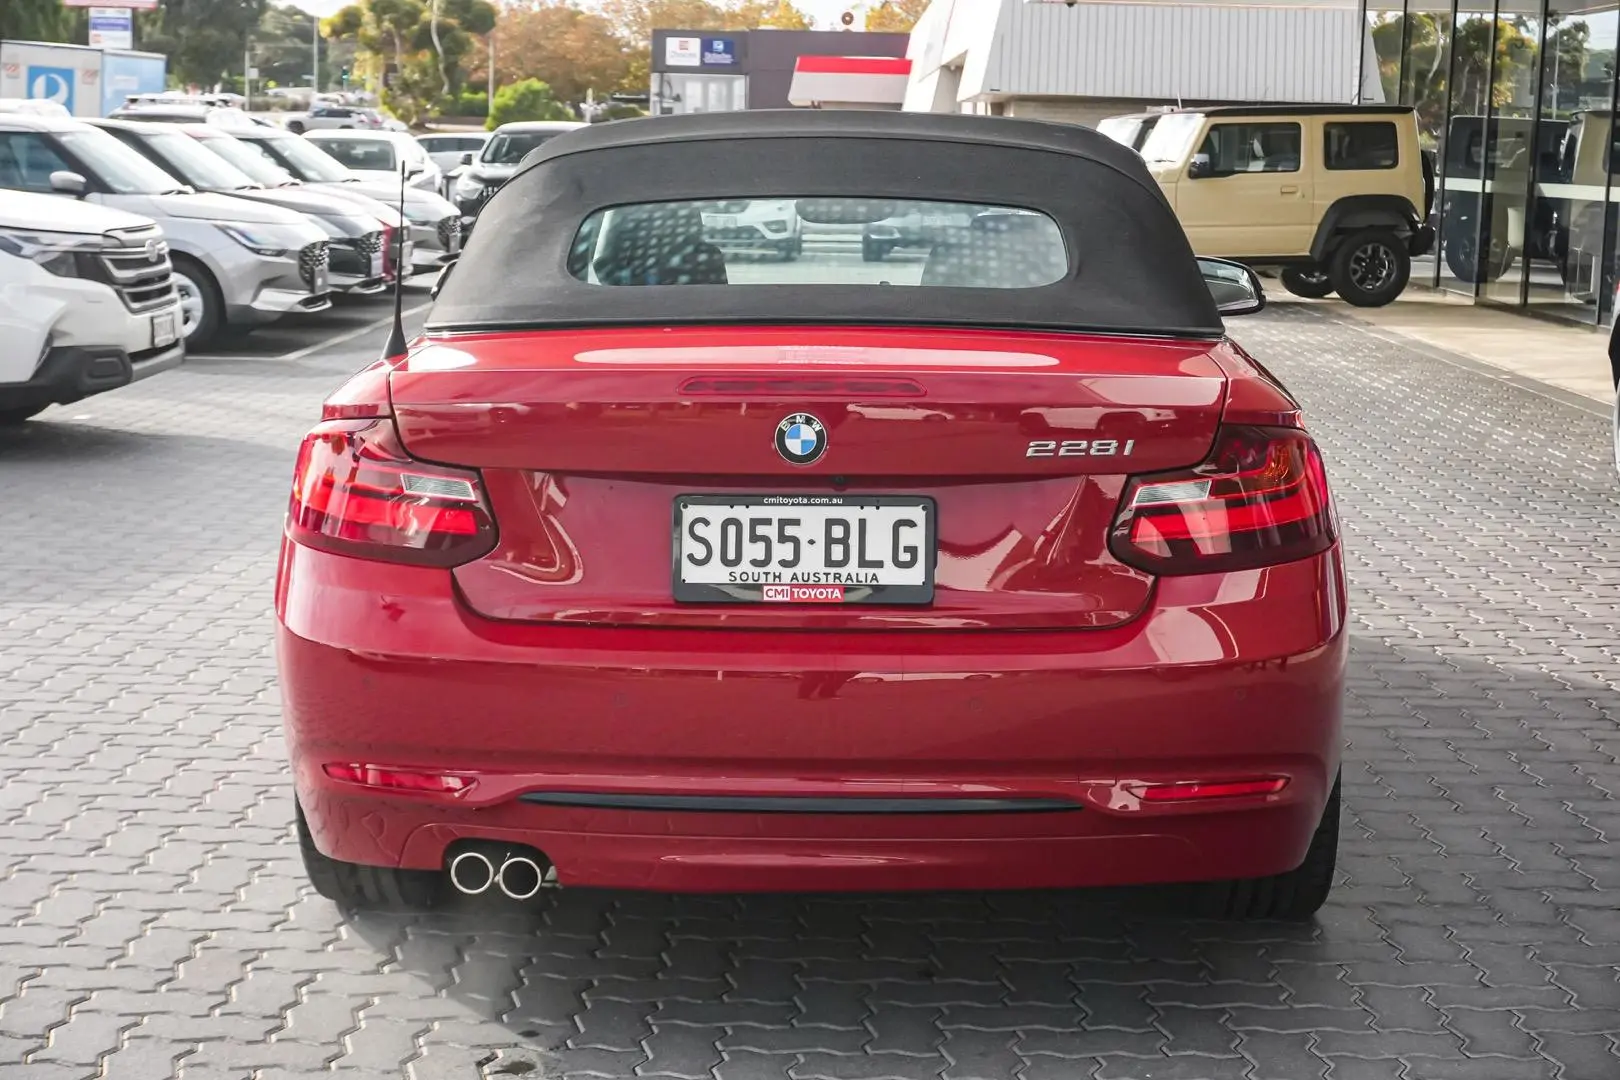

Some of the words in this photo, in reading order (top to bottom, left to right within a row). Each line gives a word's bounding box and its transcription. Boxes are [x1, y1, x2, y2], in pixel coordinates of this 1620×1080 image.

[780, 415, 822, 431] BMW
[763, 496, 843, 506] cmitoyota.com.au
[728, 571, 783, 584] SOUTH
[789, 572, 880, 584] AUSTRALIA
[765, 588, 790, 600] CMI
[792, 588, 842, 600] TOYOTA
